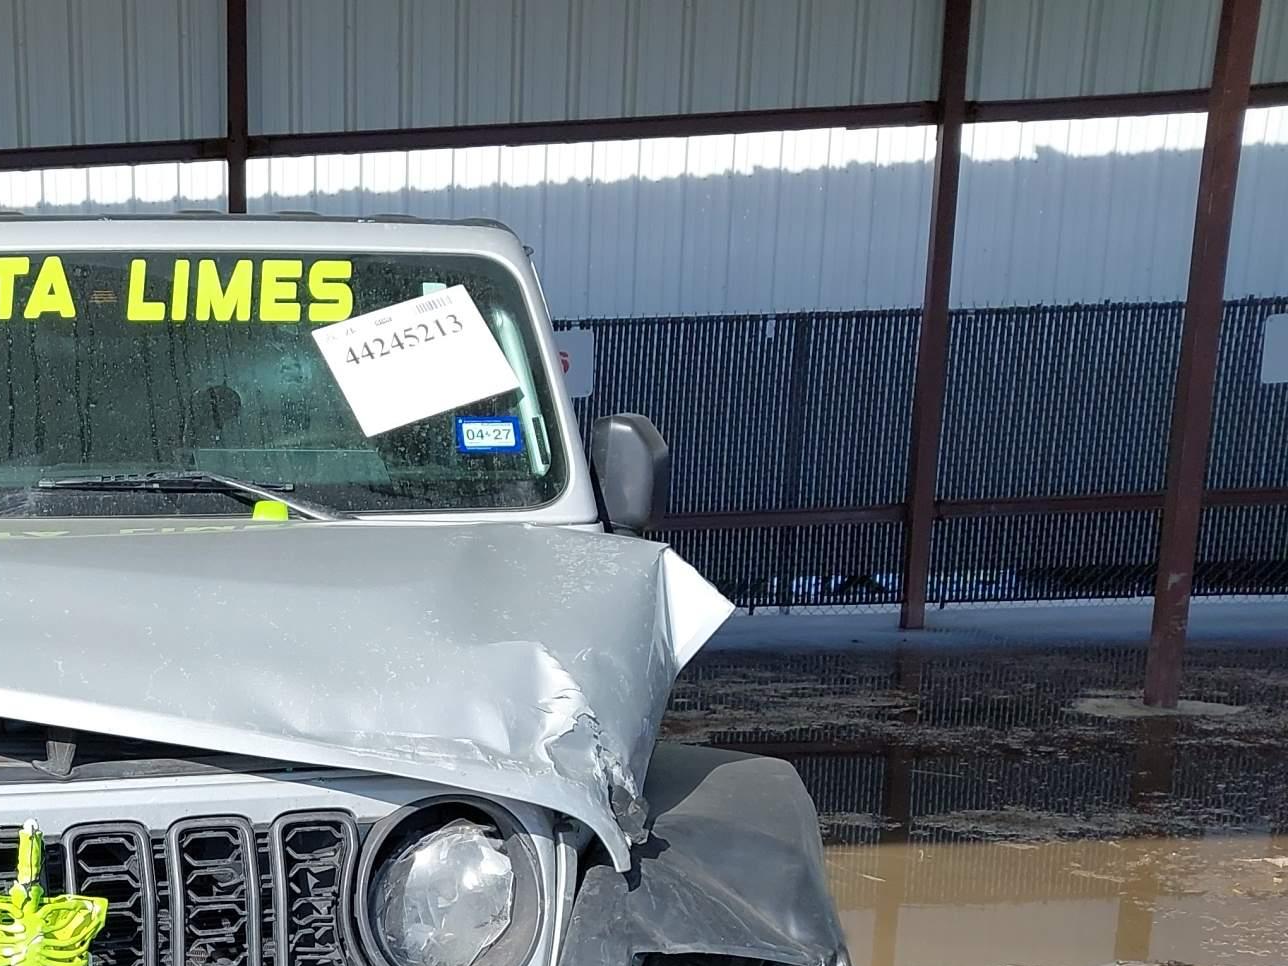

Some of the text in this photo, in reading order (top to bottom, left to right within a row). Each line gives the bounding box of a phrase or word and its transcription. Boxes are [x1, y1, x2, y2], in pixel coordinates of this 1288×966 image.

[127, 259, 354, 322] LIMES
[345, 314, 462, 365] 44245213
[466, 428, 512, 441] 04 27
